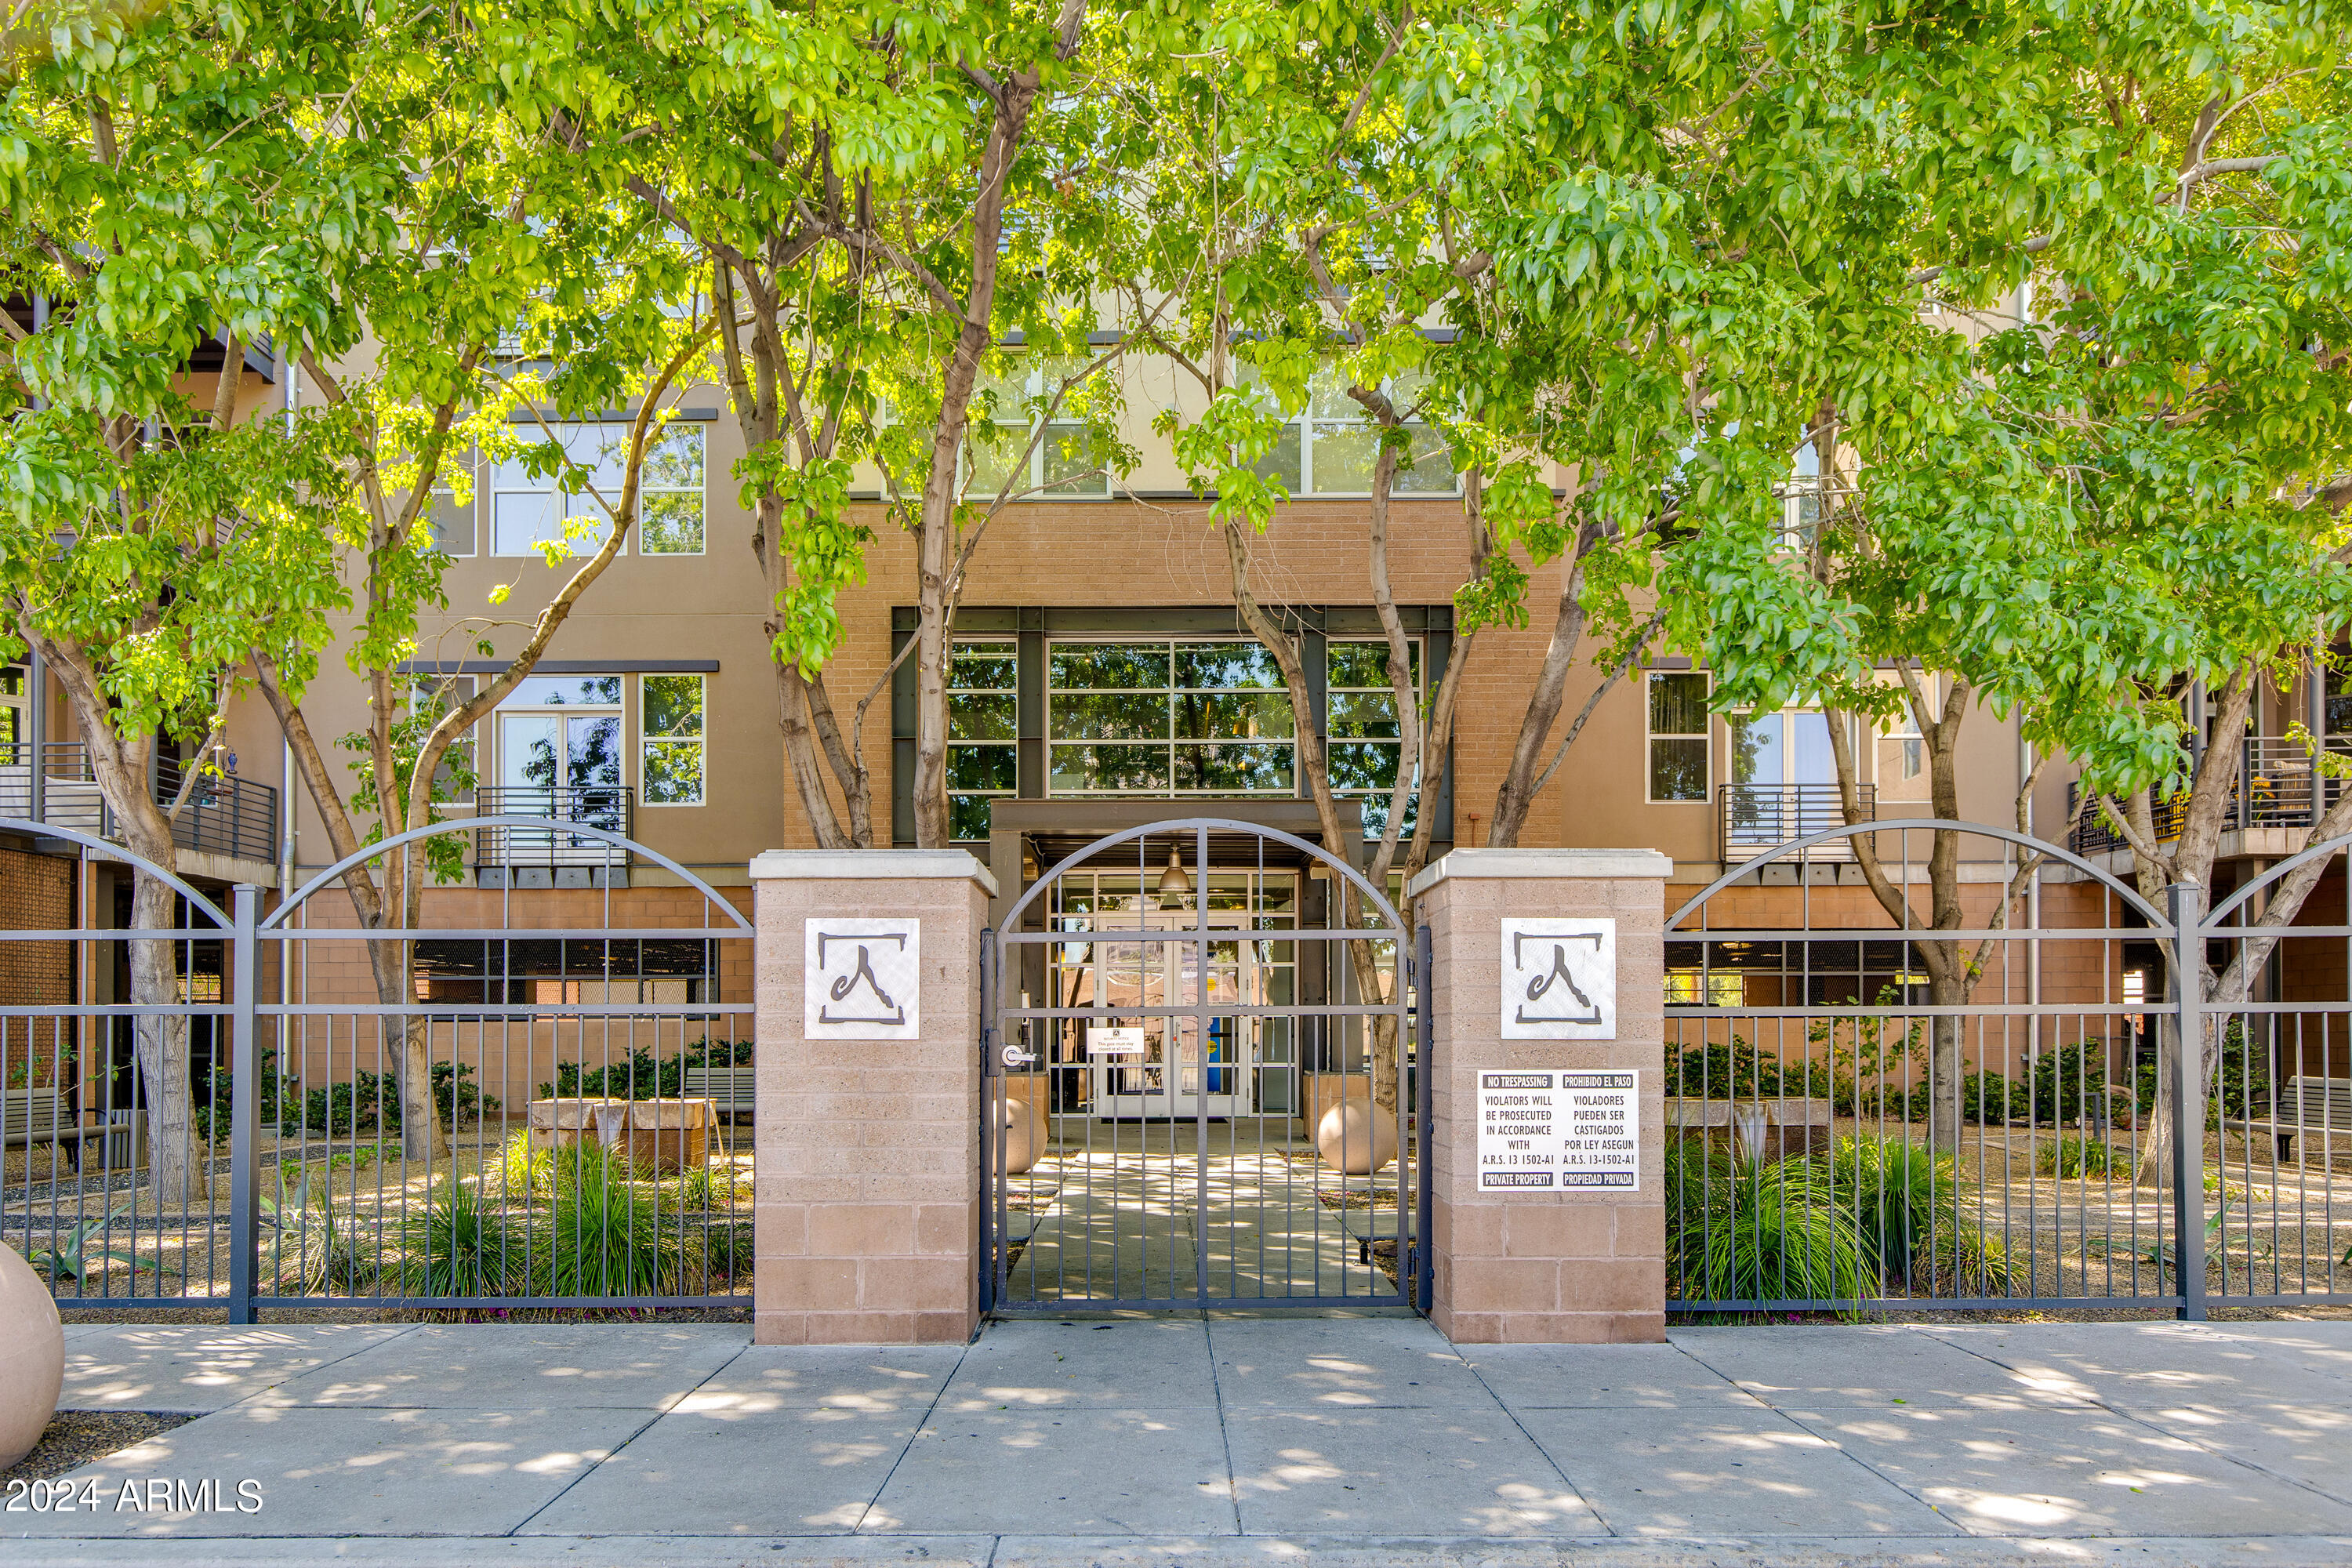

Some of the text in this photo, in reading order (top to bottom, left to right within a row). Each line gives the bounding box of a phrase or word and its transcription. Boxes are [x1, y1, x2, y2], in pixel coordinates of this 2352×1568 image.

[1487, 1076, 1548, 1087] NO TRESPASSING
[1565, 1076, 1632, 1087] PROHIBIDO EL PASO
[1486, 1096, 1552, 1105] VIOLATORS WILL
[1573, 1096, 1624, 1105] VIOLADORES
[1486, 1111, 1552, 1120] BE PROSECUTED
[1574, 1111, 1624, 1120] PUEDEN SER
[1486, 1126, 1552, 1134] IN ACCORDANCE
[1574, 1126, 1624, 1134] CASTIGADOS
[1508, 1140, 1530, 1149] WITH
[1565, 1140, 1634, 1149] POR LEY ASEGUN
[1483, 1155, 1554, 1164] A.R.S. 13 1502-A1
[1563, 1155, 1634, 1164] A.R.S. 13-1502-A1
[1486, 1174, 1551, 1185] PRIVATE PROPERTY
[1565, 1174, 1632, 1185] PROPIEDAD PRIVADA
